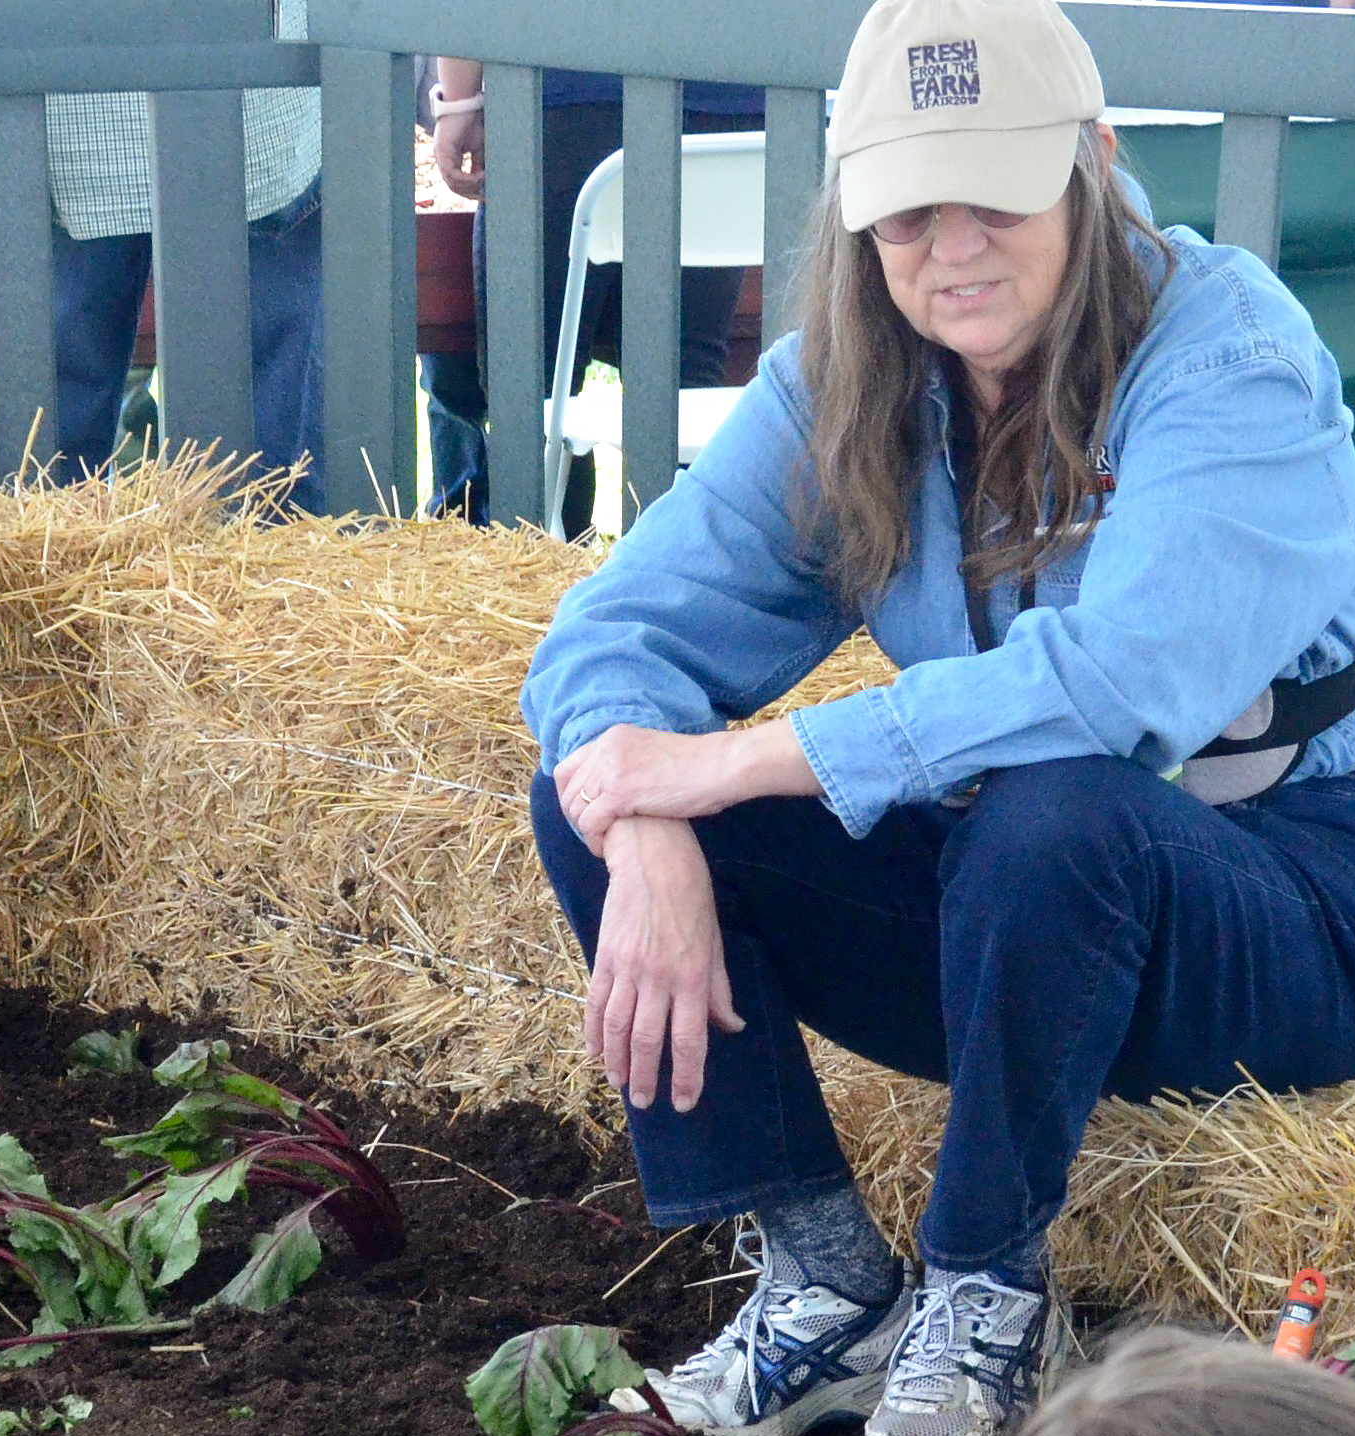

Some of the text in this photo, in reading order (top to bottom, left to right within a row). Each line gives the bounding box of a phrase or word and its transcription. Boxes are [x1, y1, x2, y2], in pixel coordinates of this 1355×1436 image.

[907, 39, 978, 67] FRESH
[910, 61, 978, 80] FROM THE
[910, 74, 981, 102] FARM
